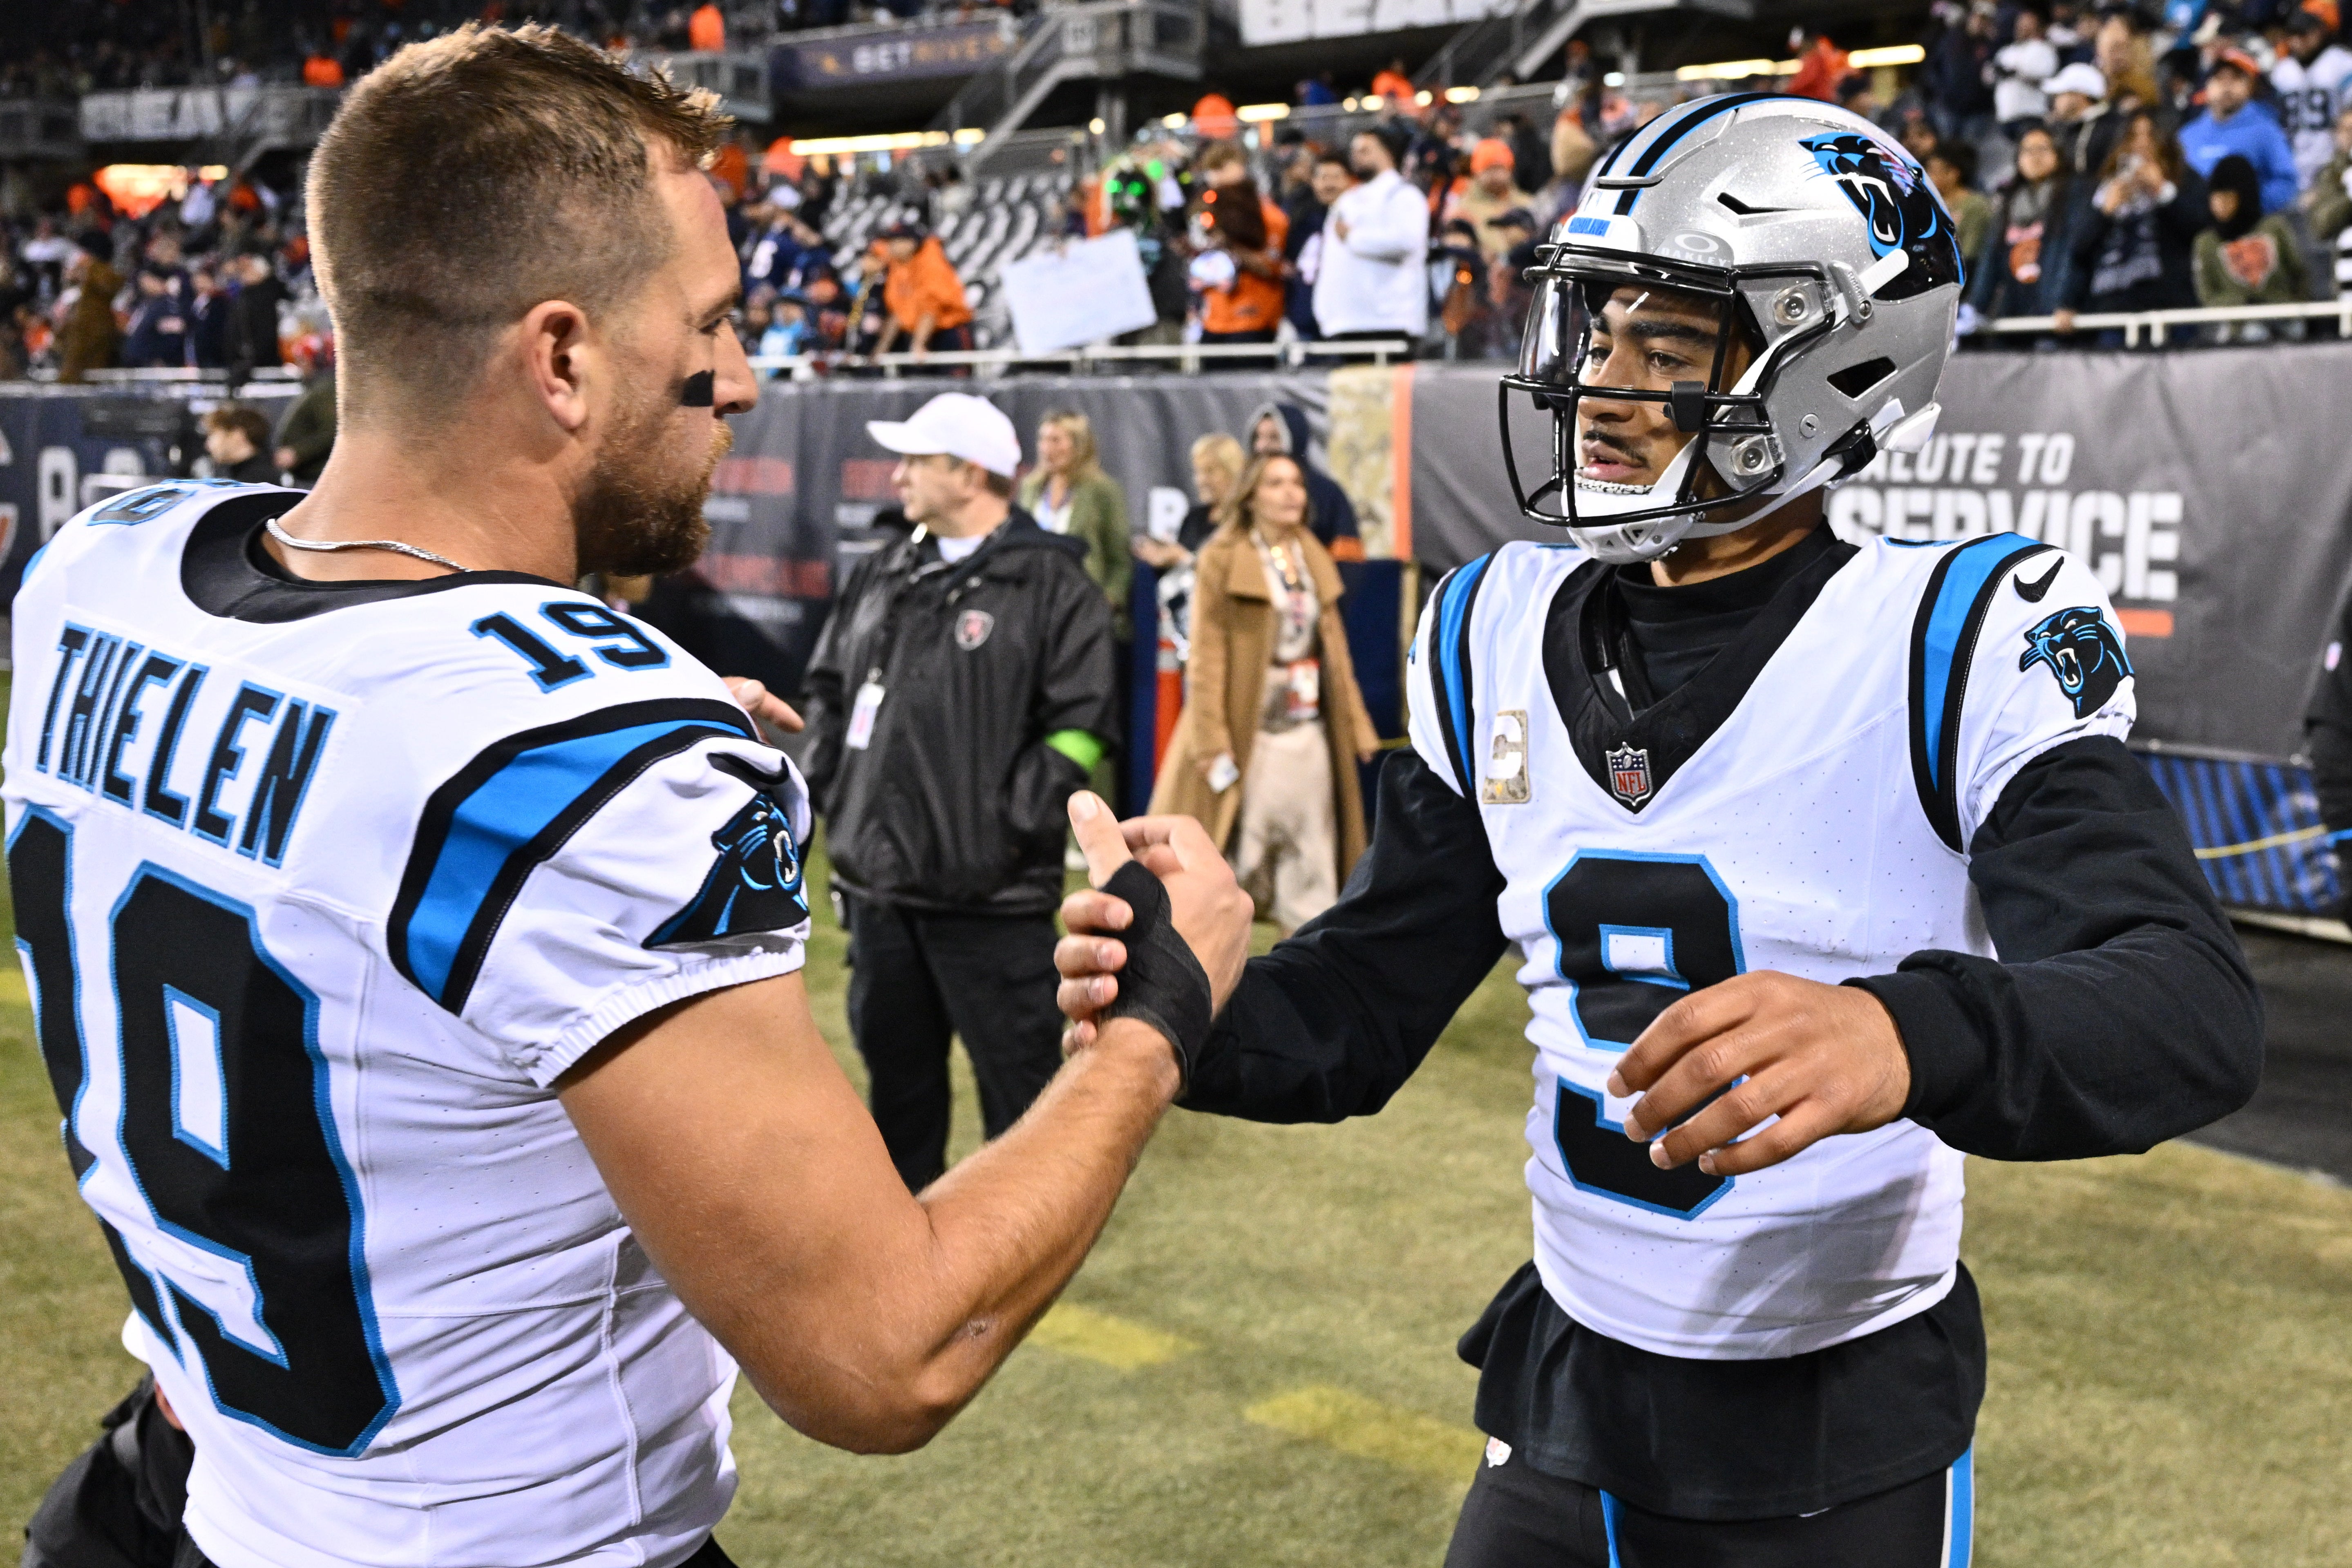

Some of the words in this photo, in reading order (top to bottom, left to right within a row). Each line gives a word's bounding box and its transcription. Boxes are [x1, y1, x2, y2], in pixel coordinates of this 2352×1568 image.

[1661, 248, 1726, 266] OAKLEY
[1853, 433, 2005, 484] ALUTE
[2018, 433, 2075, 485] TO
[470, 601, 671, 694] 19
[37, 620, 337, 869] THIELEN
[1487, 715, 1522, 779] C
[1616, 771, 1646, 795] NFL
[1541, 848, 1747, 1222] 9
[3, 802, 402, 1459] 19
